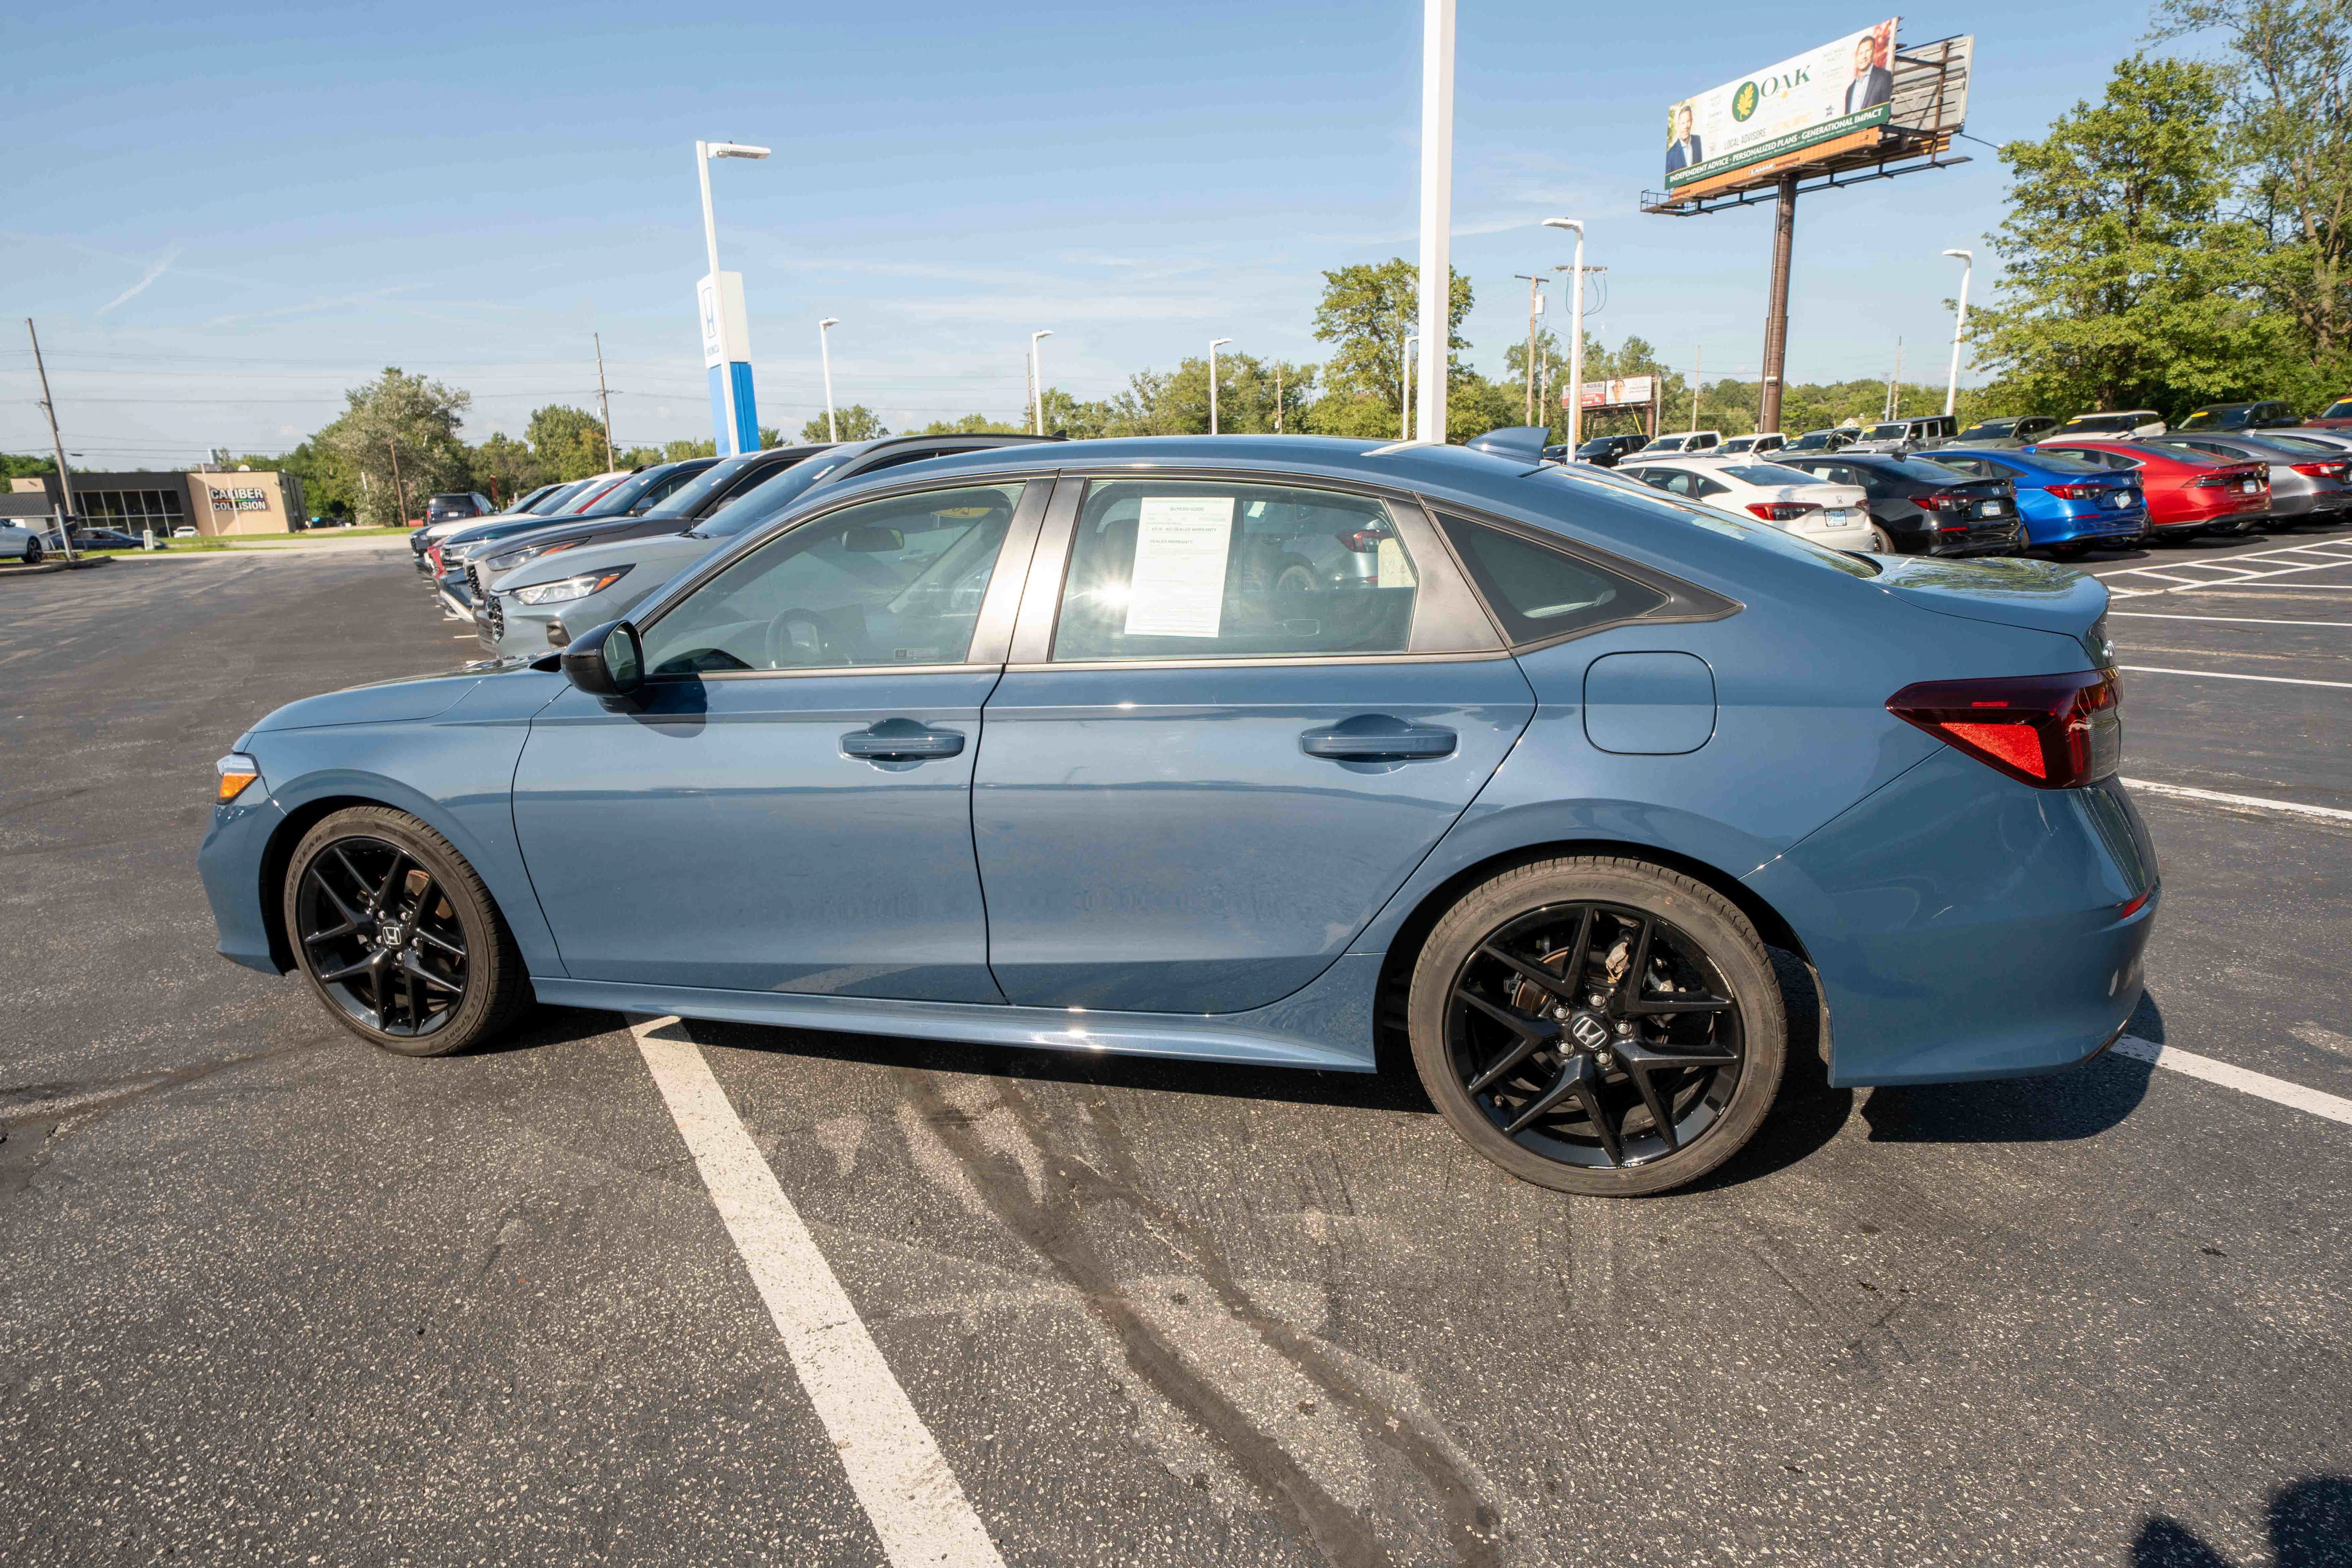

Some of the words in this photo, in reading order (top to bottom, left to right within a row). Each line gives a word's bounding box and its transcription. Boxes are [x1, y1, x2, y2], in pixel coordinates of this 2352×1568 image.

[1761, 64, 1811, 97] OAK
[1670, 164, 1708, 183] INDEPENDENT
[1707, 157, 1729, 169] ADVICE
[1732, 142, 1776, 162] PERSONALIZED
[1777, 134, 1798, 147] PLANS
[1801, 117, 1853, 140] GENERATIONAL
[1854, 108, 1883, 123] IMPACT
[1724, 138, 1739, 150] LOCAL
[1742, 128, 1766, 143] ADVISORS
[210, 488, 263, 499] CALIBER
[213, 501, 266, 511] COLLISION
